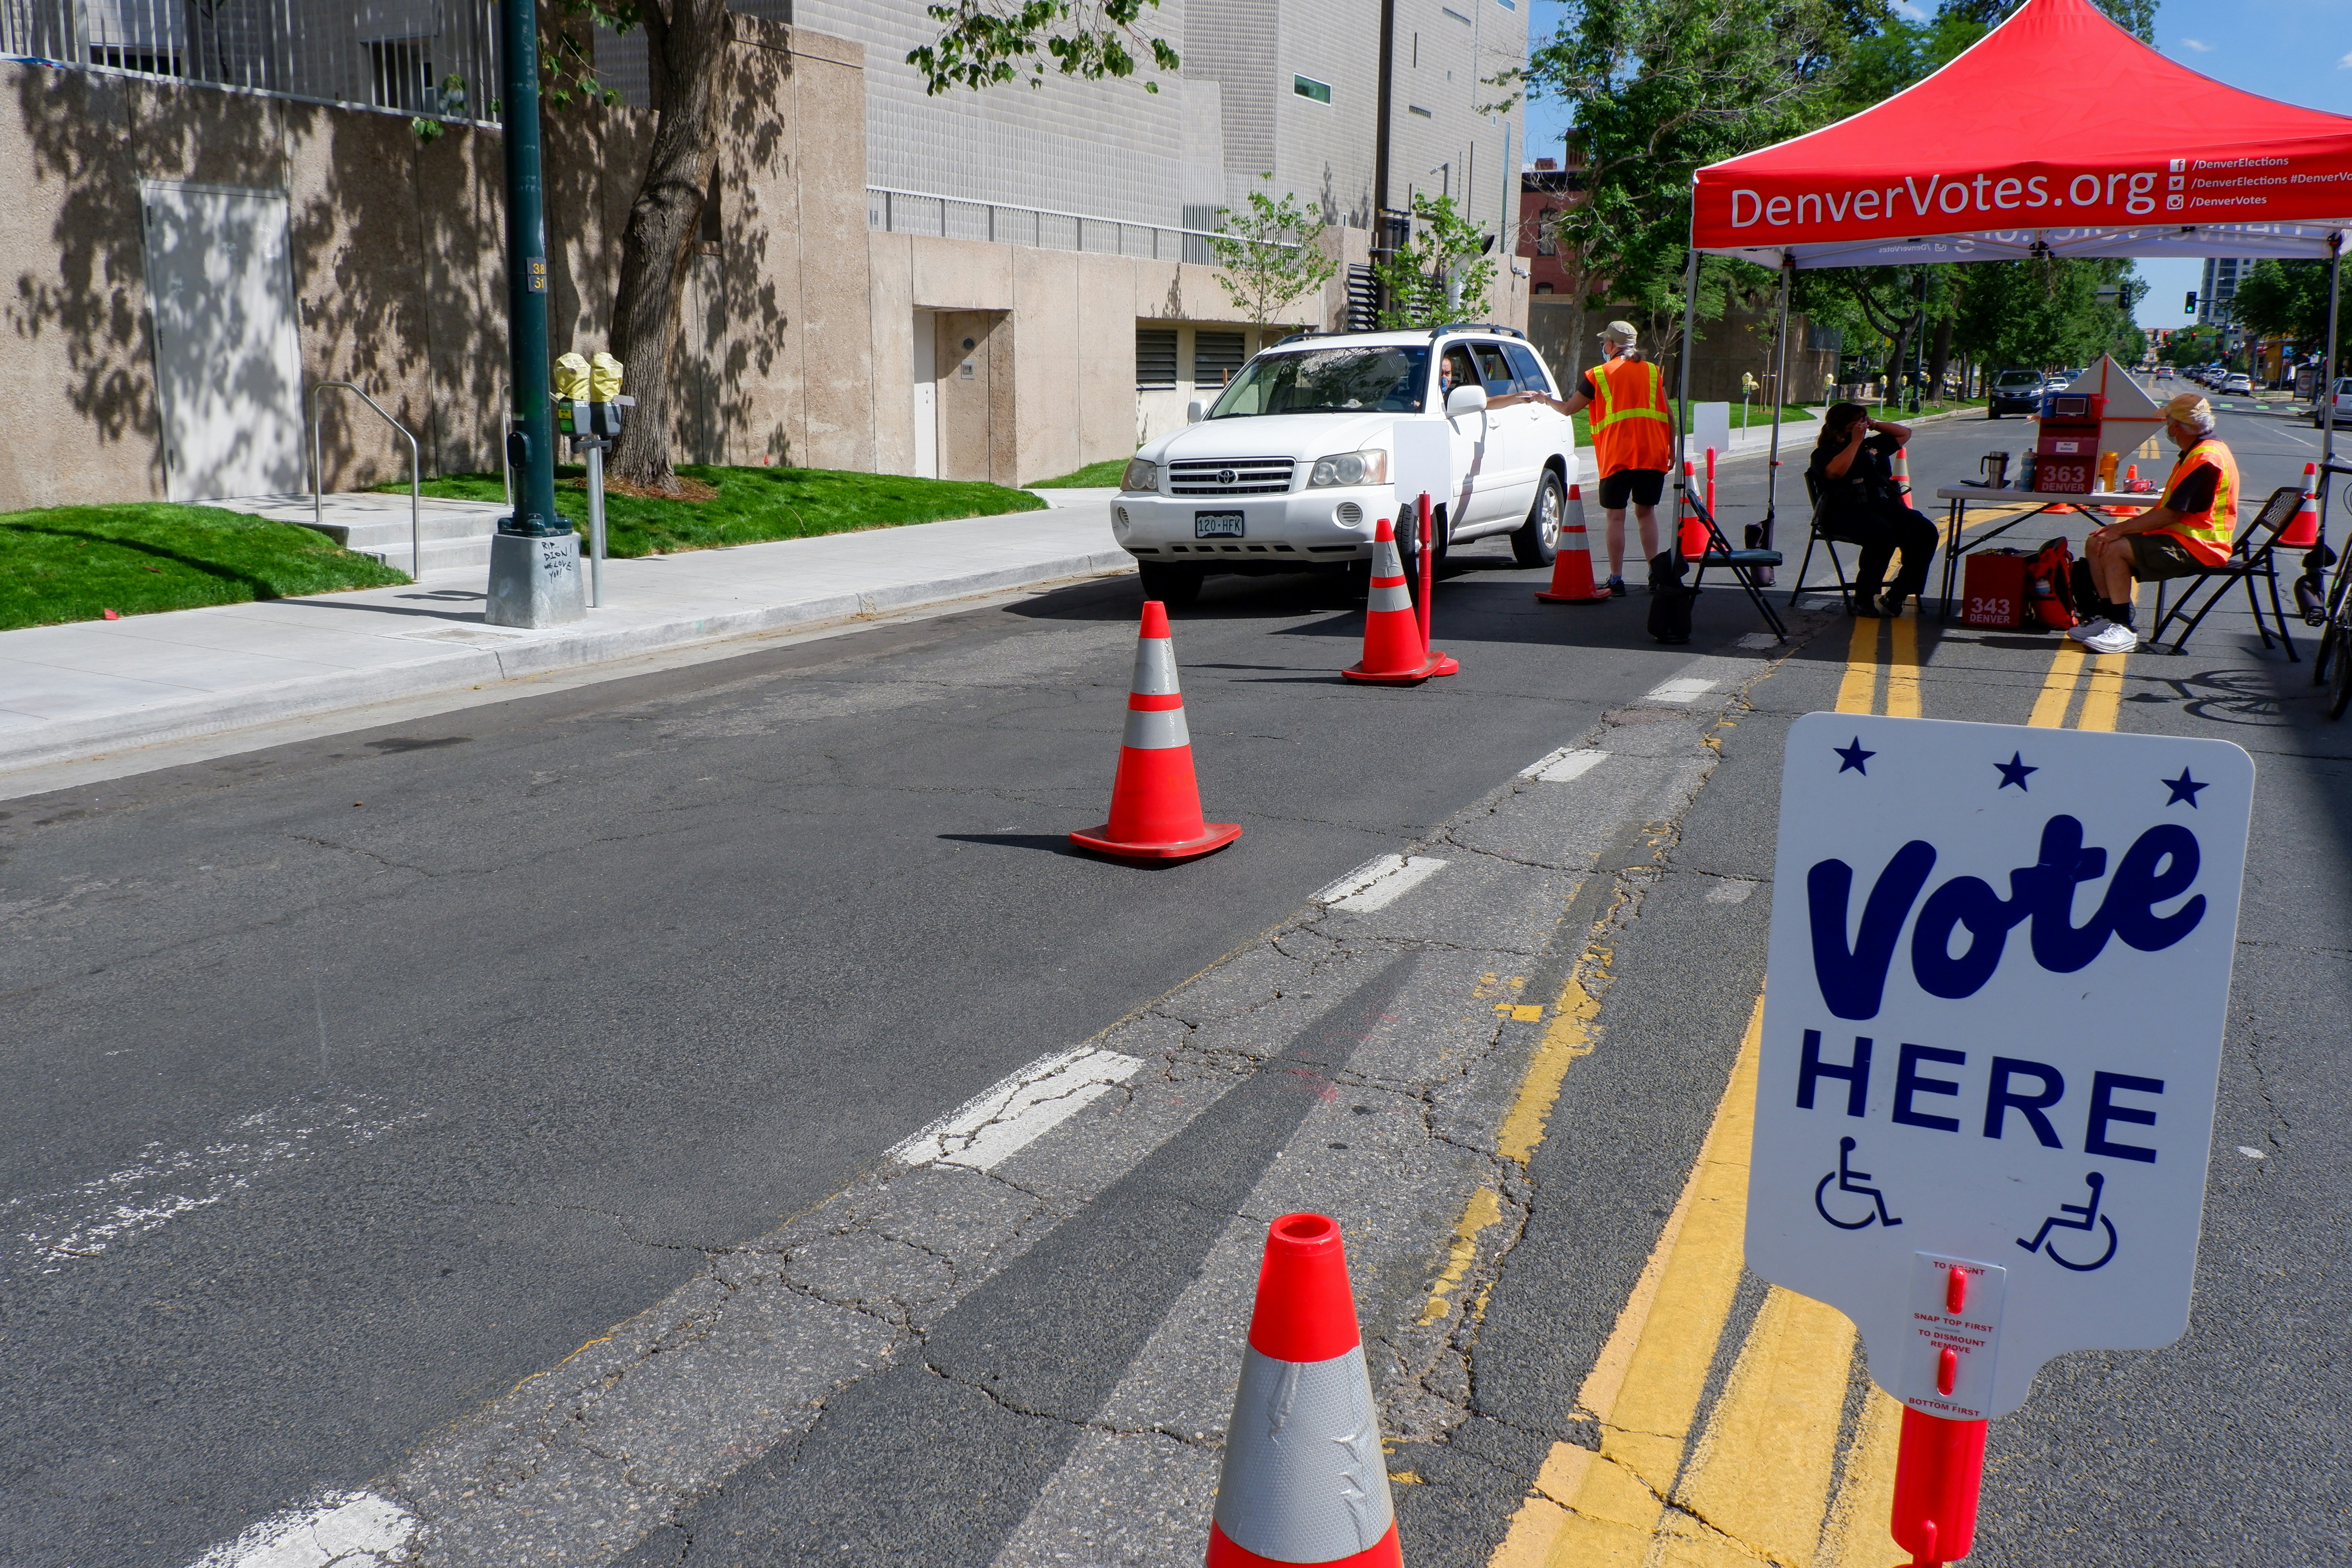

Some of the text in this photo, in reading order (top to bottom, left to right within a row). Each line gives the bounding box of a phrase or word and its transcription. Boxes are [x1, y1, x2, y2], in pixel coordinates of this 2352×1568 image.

[2192, 157, 2289, 171] /DenverElections
[2191, 176, 2287, 190] /DenverElections
[1732, 172, 2157, 228] DenverVotes.org
[2189, 197, 2267, 208] /DenverVotes
[533, 263, 545, 274] 38
[534, 277, 544, 289] 51
[2043, 466, 2085, 482] 363
[2042, 482, 2085, 492] DENVER
[543, 543, 572, 561] DION!
[554, 560, 572, 571] LOVE
[1971, 597, 2010, 615] 343
[1970, 613, 2010, 624] DENVER
[1807, 814, 2207, 1020] Vote
[1796, 1028, 2165, 1164] HERE
[1913, 1312, 1994, 1333] SNAP TOP FIRST
[1934, 1332, 1986, 1347] DISMOUNT
[1930, 1340, 1971, 1354] REMOVE
[1909, 1397, 1980, 1417] BOTTOM FIRST
